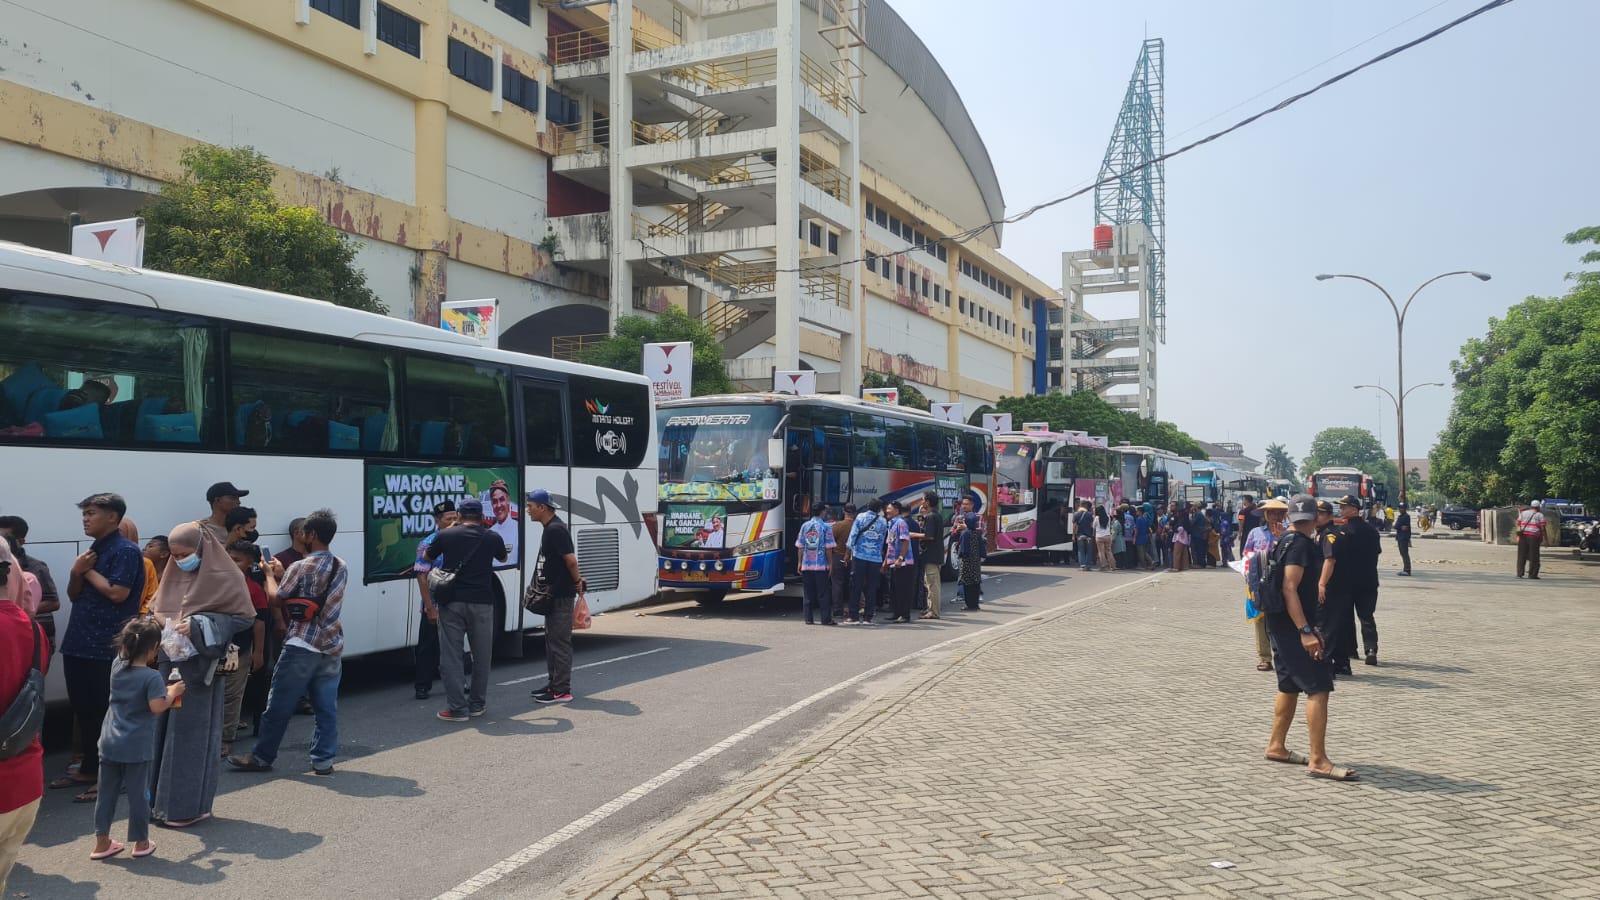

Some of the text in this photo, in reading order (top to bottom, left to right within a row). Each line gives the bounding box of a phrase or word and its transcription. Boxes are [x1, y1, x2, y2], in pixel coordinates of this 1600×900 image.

[666, 414, 751, 426] PARIWISATA
[385, 474, 465, 493] WARGANE
[764, 489, 777, 499] 03
[373, 495, 408, 515] PAK
[671, 512, 701, 520] WARGANE
[665, 519, 705, 527] PAK GANJAR
